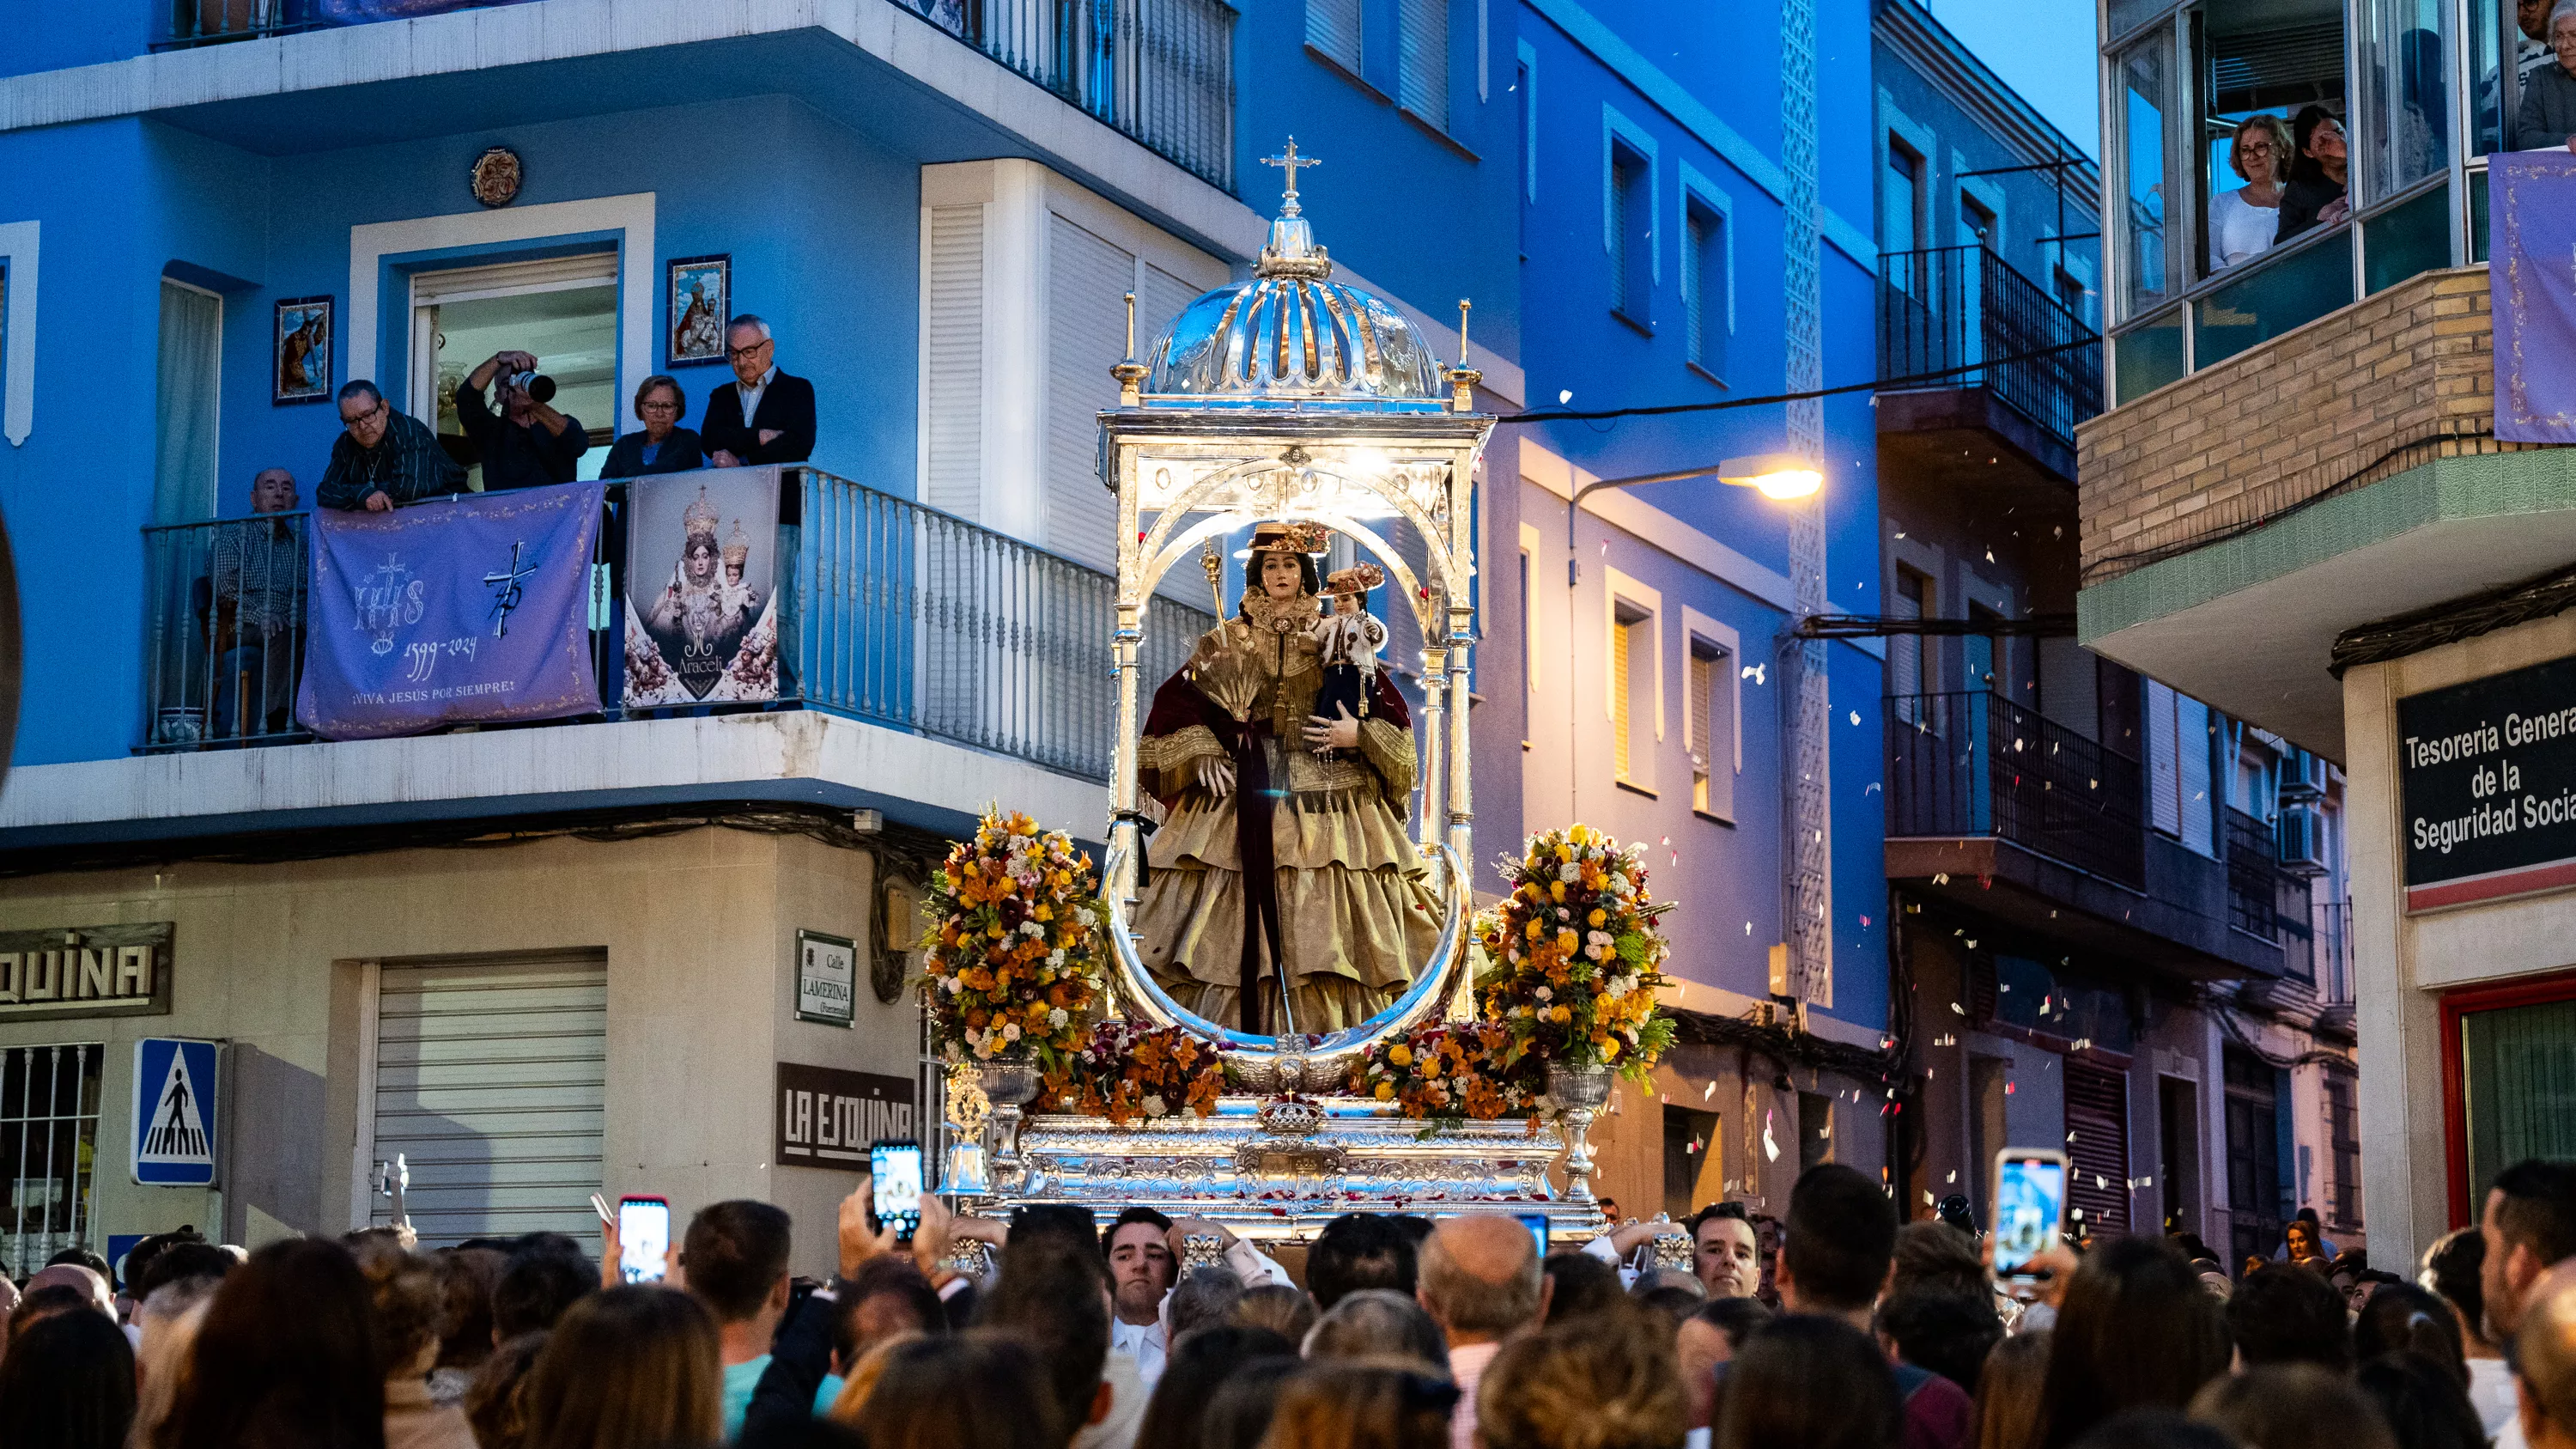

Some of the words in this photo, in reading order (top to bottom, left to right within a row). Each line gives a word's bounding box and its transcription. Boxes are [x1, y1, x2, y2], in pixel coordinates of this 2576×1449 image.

[404, 636, 477, 682] 1599-2024
[678, 654, 722, 674] Araceli
[388, 689, 428, 703] JESÚS
[432, 687, 453, 700] POR
[455, 680, 515, 697] SIEMPRE!
[2471, 764, 2496, 799] de
[2502, 759, 2521, 792] la
[2414, 799, 2516, 854] Seguridad
[826, 953, 845, 970] Calle
[802, 978, 849, 1002] LAMERINA
[785, 1089, 811, 1143] LA
